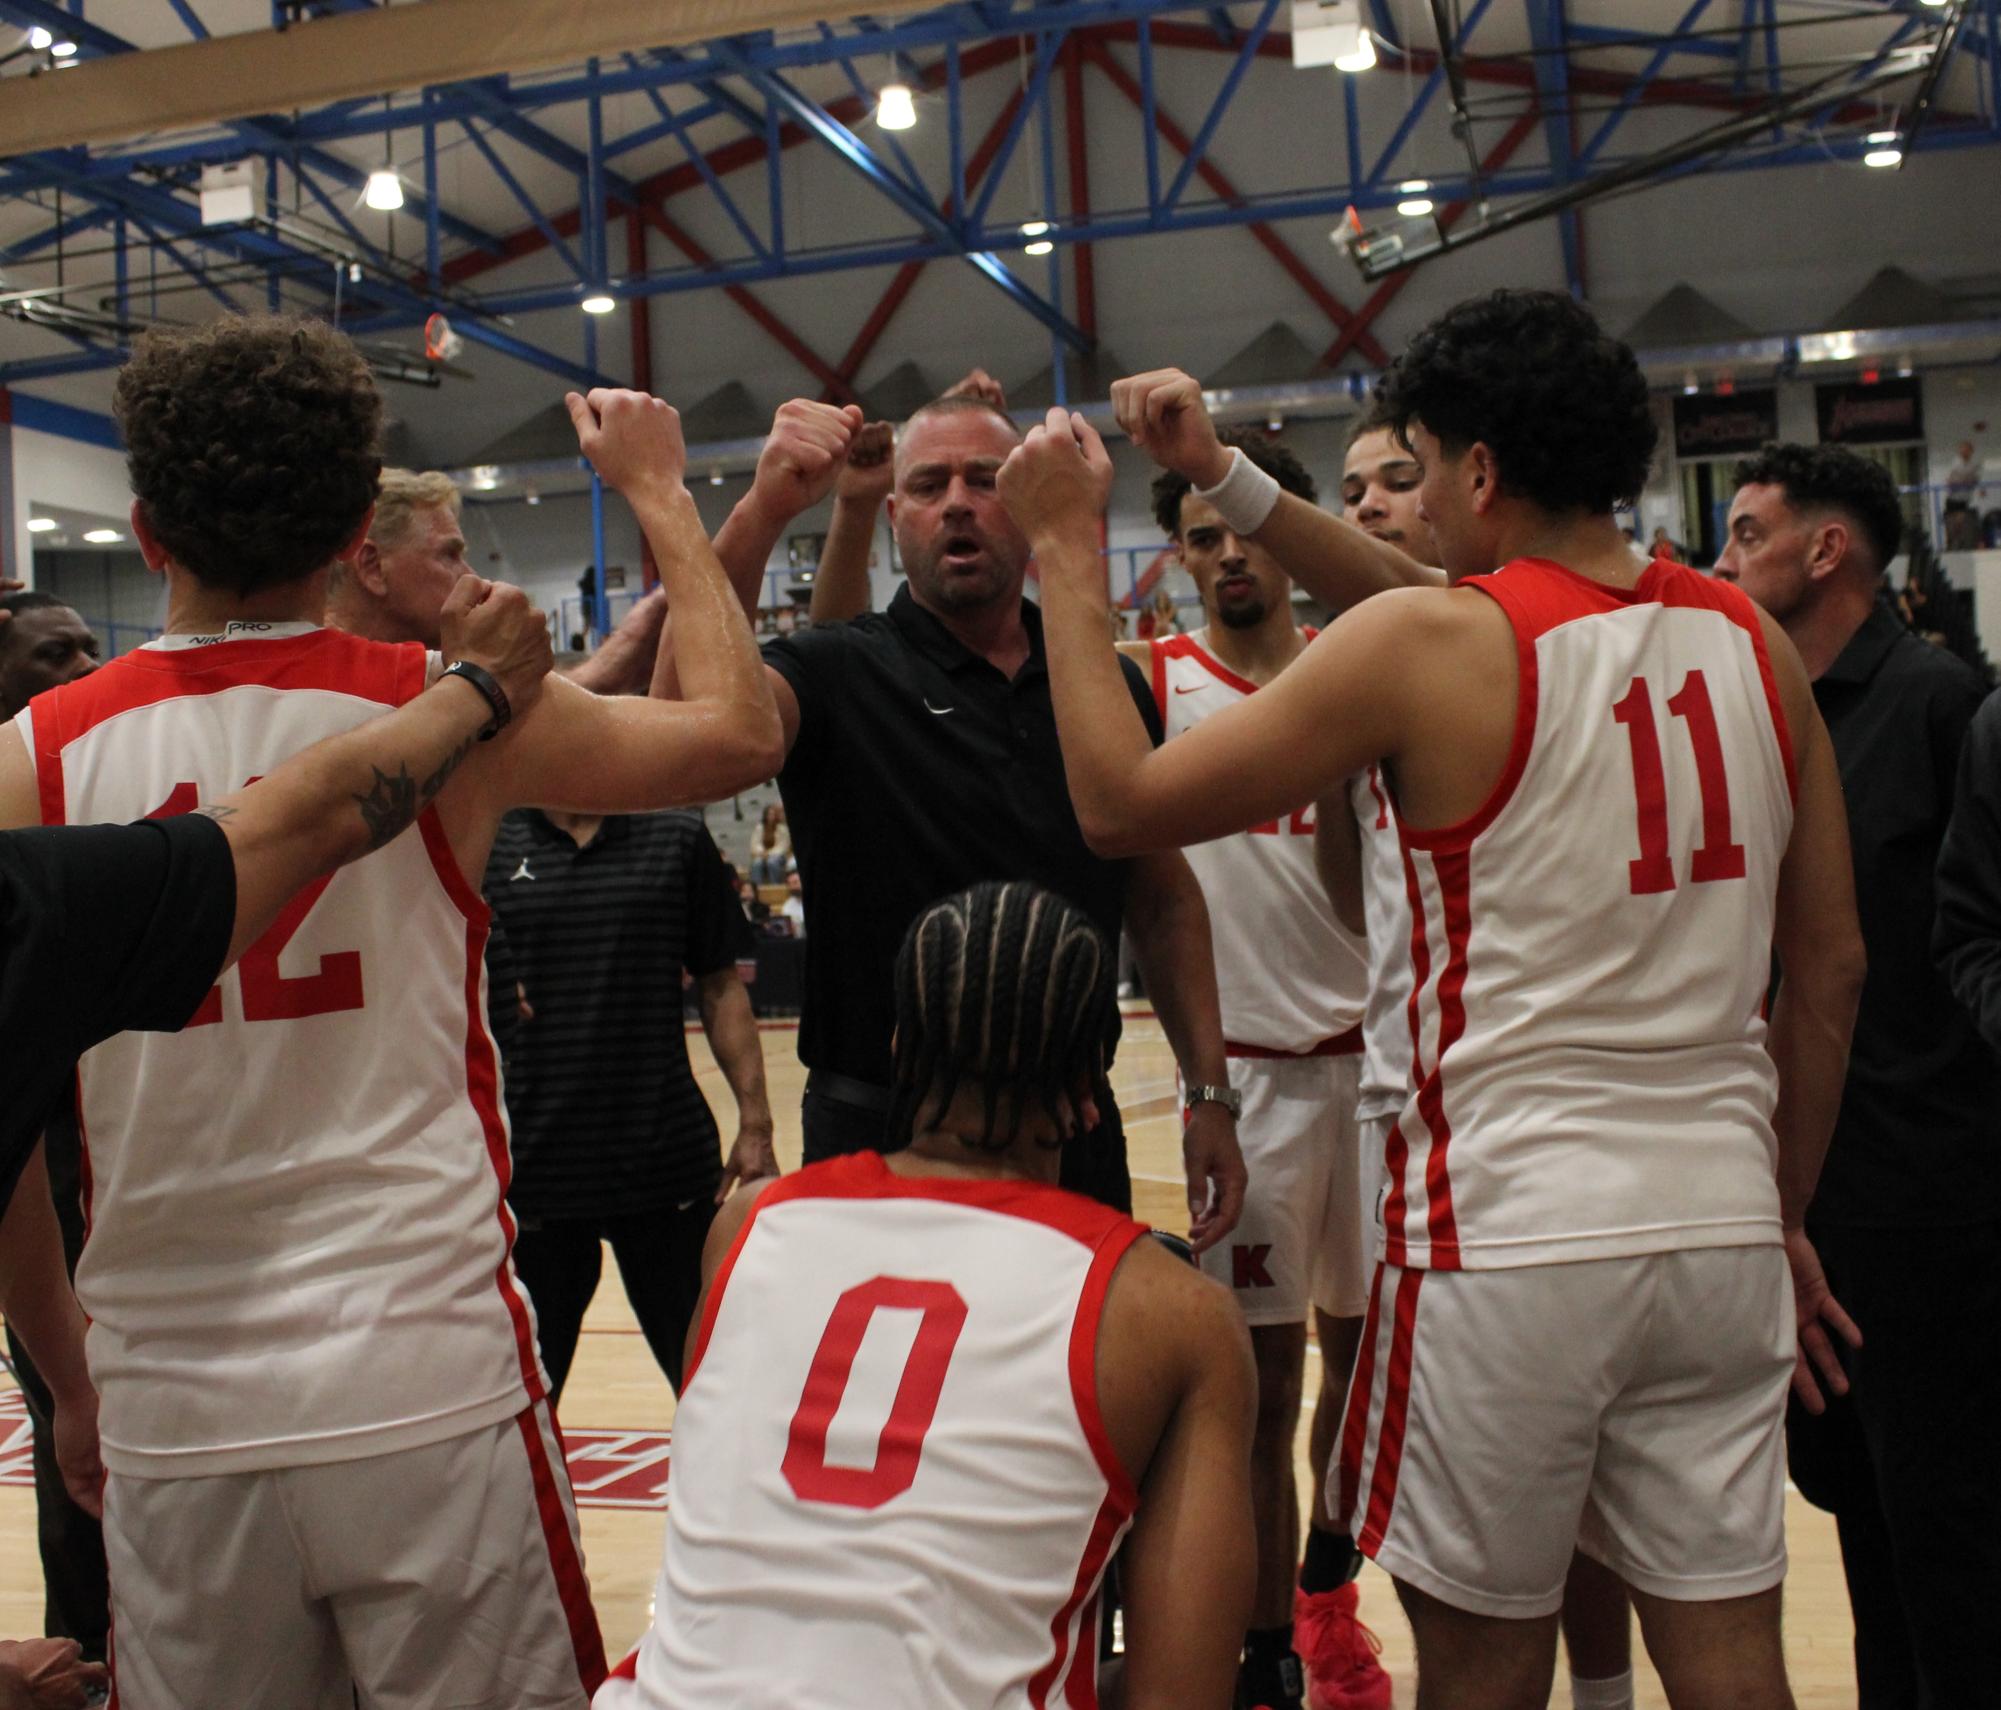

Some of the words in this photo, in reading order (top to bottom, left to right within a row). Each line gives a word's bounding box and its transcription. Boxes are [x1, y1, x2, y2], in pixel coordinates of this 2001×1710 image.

[228, 622, 272, 634] PRO
[1612, 669, 1746, 895] 11
[142, 775, 365, 1029] 2
[1232, 1244, 1276, 1289] K
[779, 1274, 969, 1511] 0
